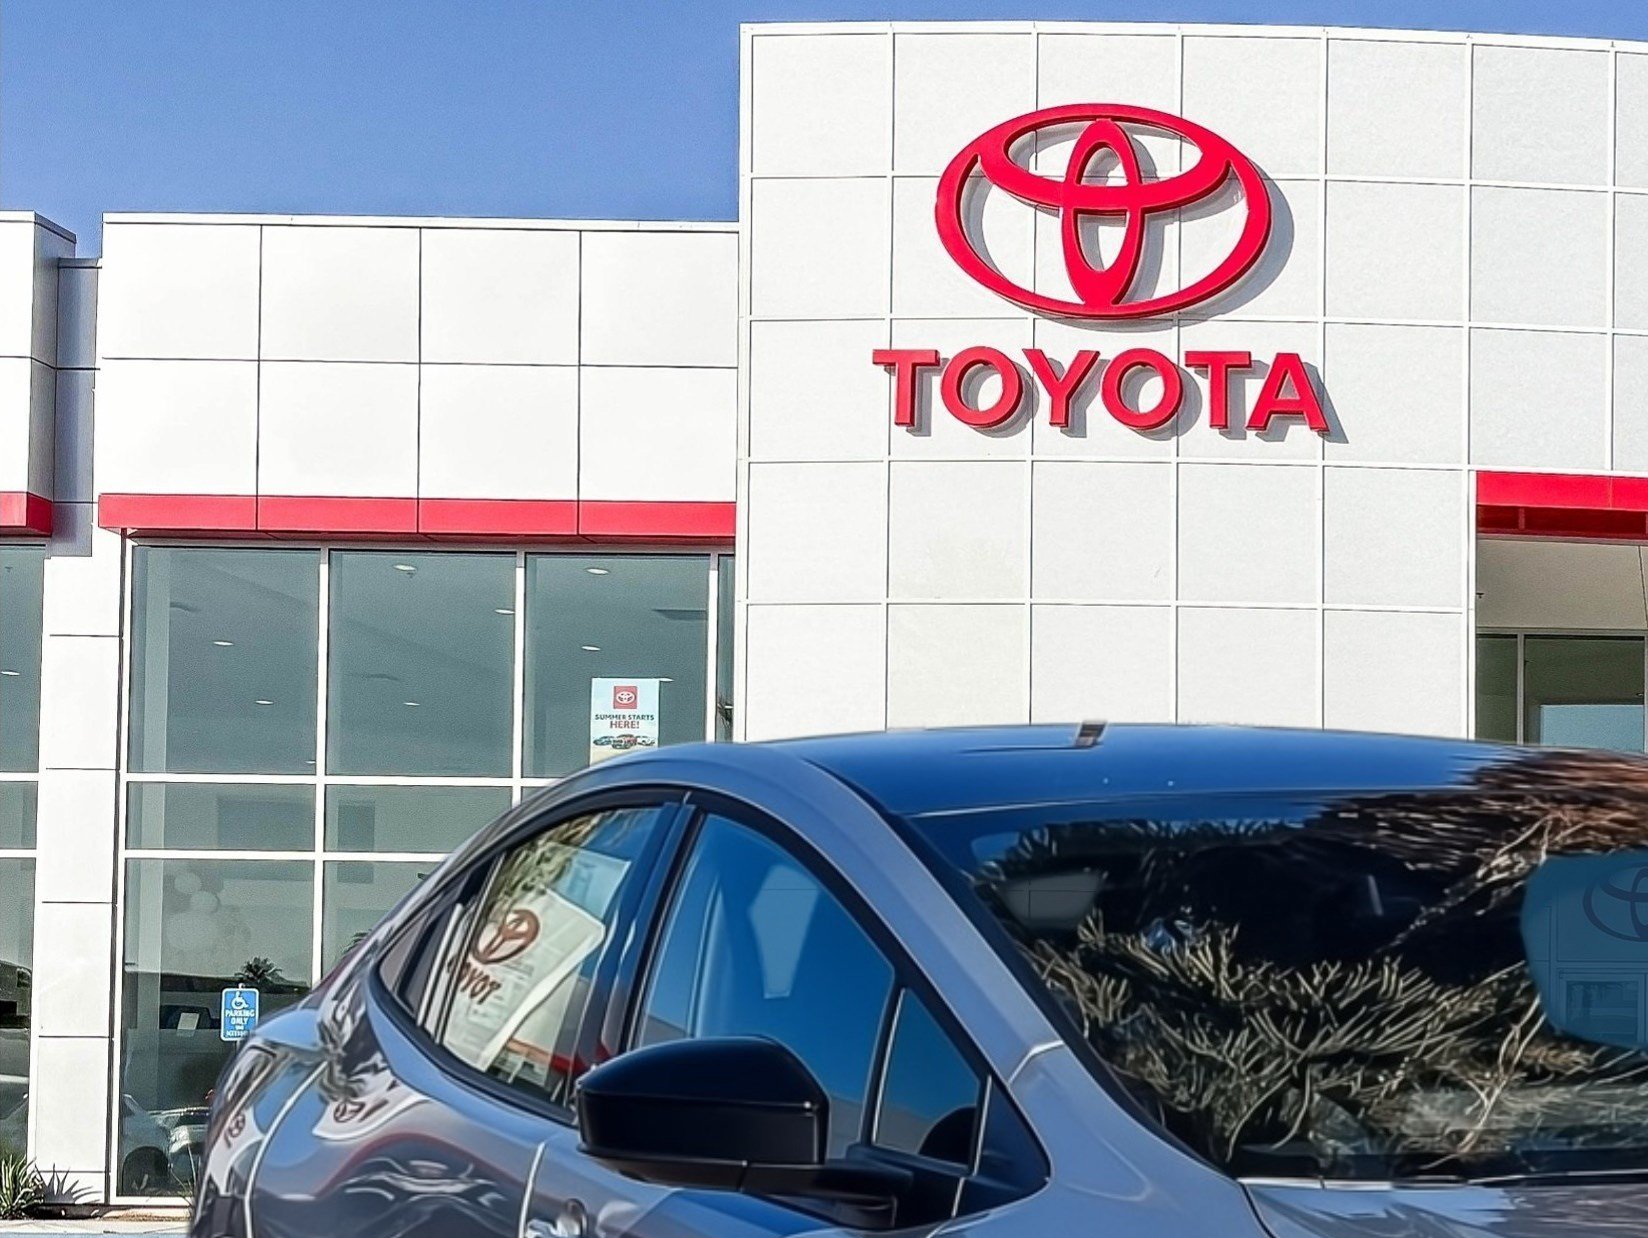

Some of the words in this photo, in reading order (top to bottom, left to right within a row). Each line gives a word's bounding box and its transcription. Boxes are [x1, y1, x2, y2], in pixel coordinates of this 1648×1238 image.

[873, 346, 1329, 432] TOYOTA
[609, 720, 640, 729] HERE!
[225, 1009, 255, 1017] PARKING
[230, 1017, 249, 1025] ONLY
